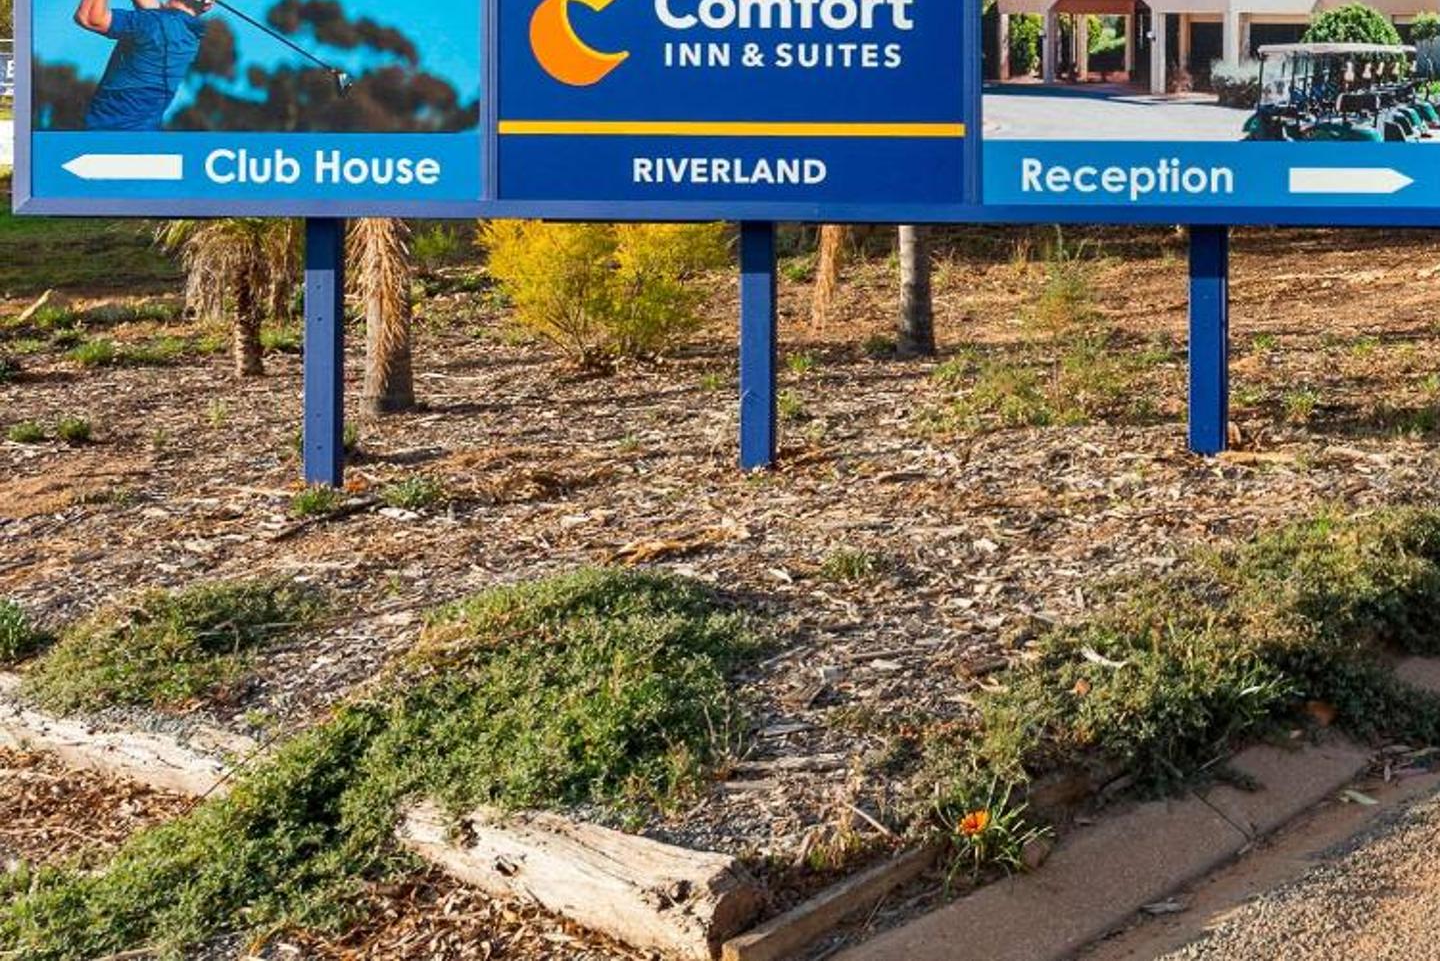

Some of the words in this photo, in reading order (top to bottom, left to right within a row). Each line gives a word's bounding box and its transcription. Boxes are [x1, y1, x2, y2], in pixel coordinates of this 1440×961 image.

[665, 43, 730, 67] INN
[742, 43, 764, 67] &
[775, 43, 901, 68] SUITES
[204, 148, 300, 184] Club
[315, 150, 441, 184] House
[633, 158, 827, 184] RIVERLAND
[1021, 158, 1234, 201] Reception
